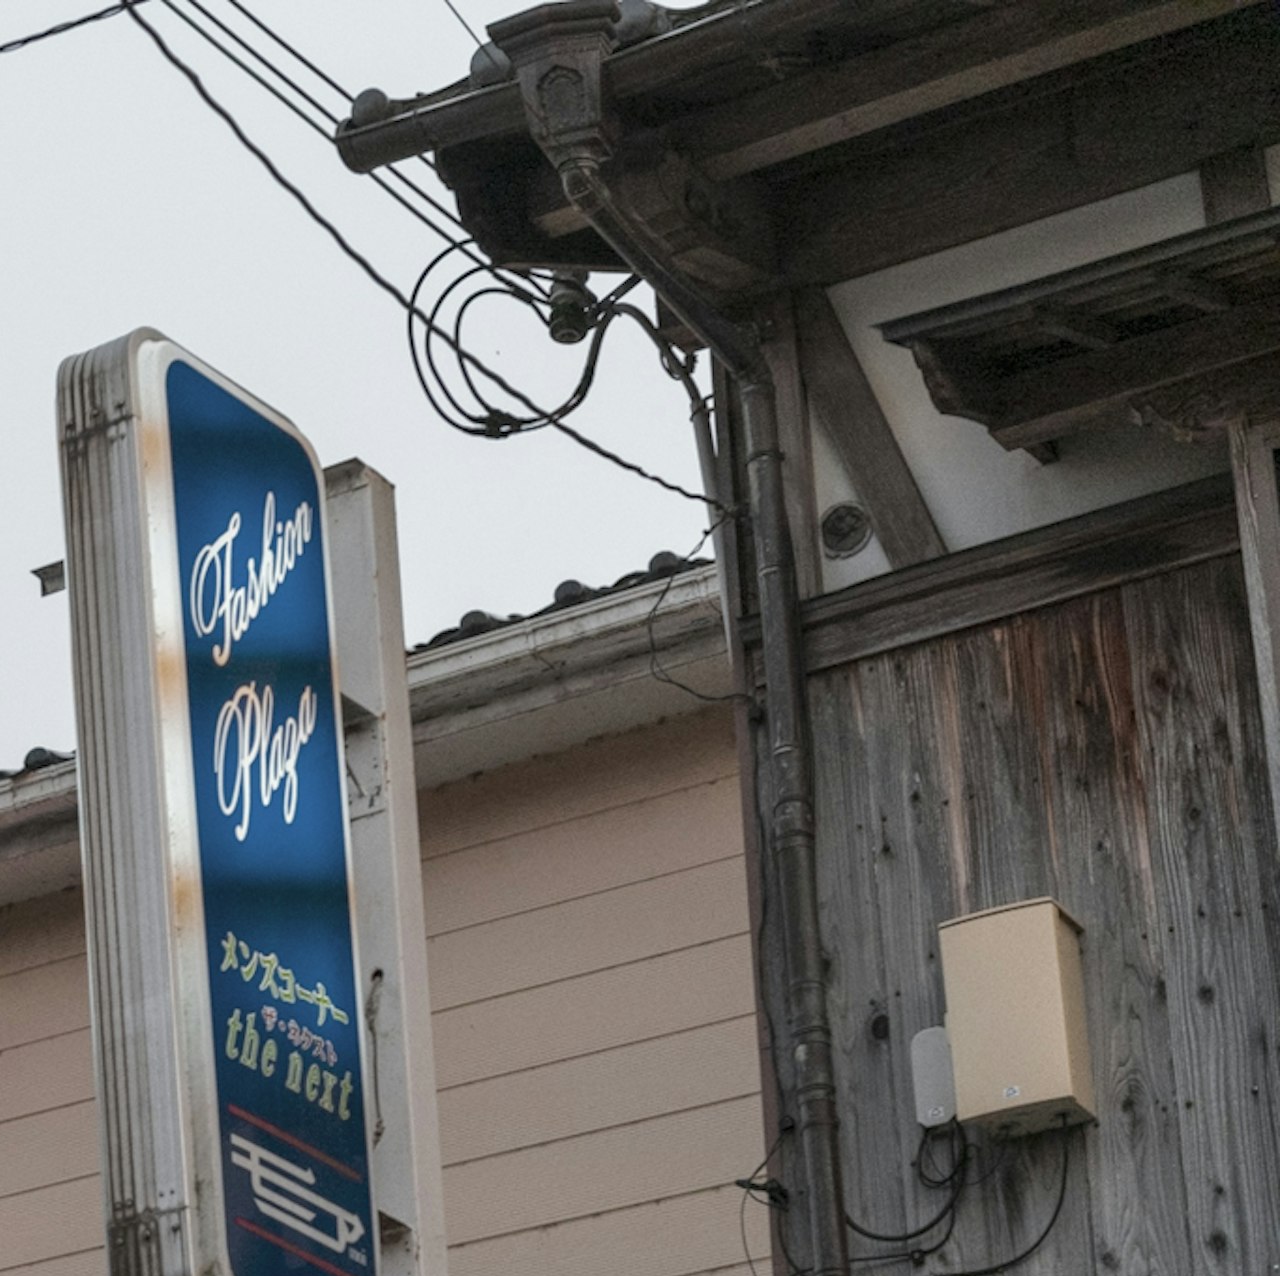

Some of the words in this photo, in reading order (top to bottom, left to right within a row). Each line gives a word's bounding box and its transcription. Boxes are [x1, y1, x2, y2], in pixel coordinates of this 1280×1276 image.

[190, 491, 312, 667] Fashion
[214, 681, 317, 841] Plaza
[225, 1008, 278, 1077] the
[285, 1051, 354, 1121] next
